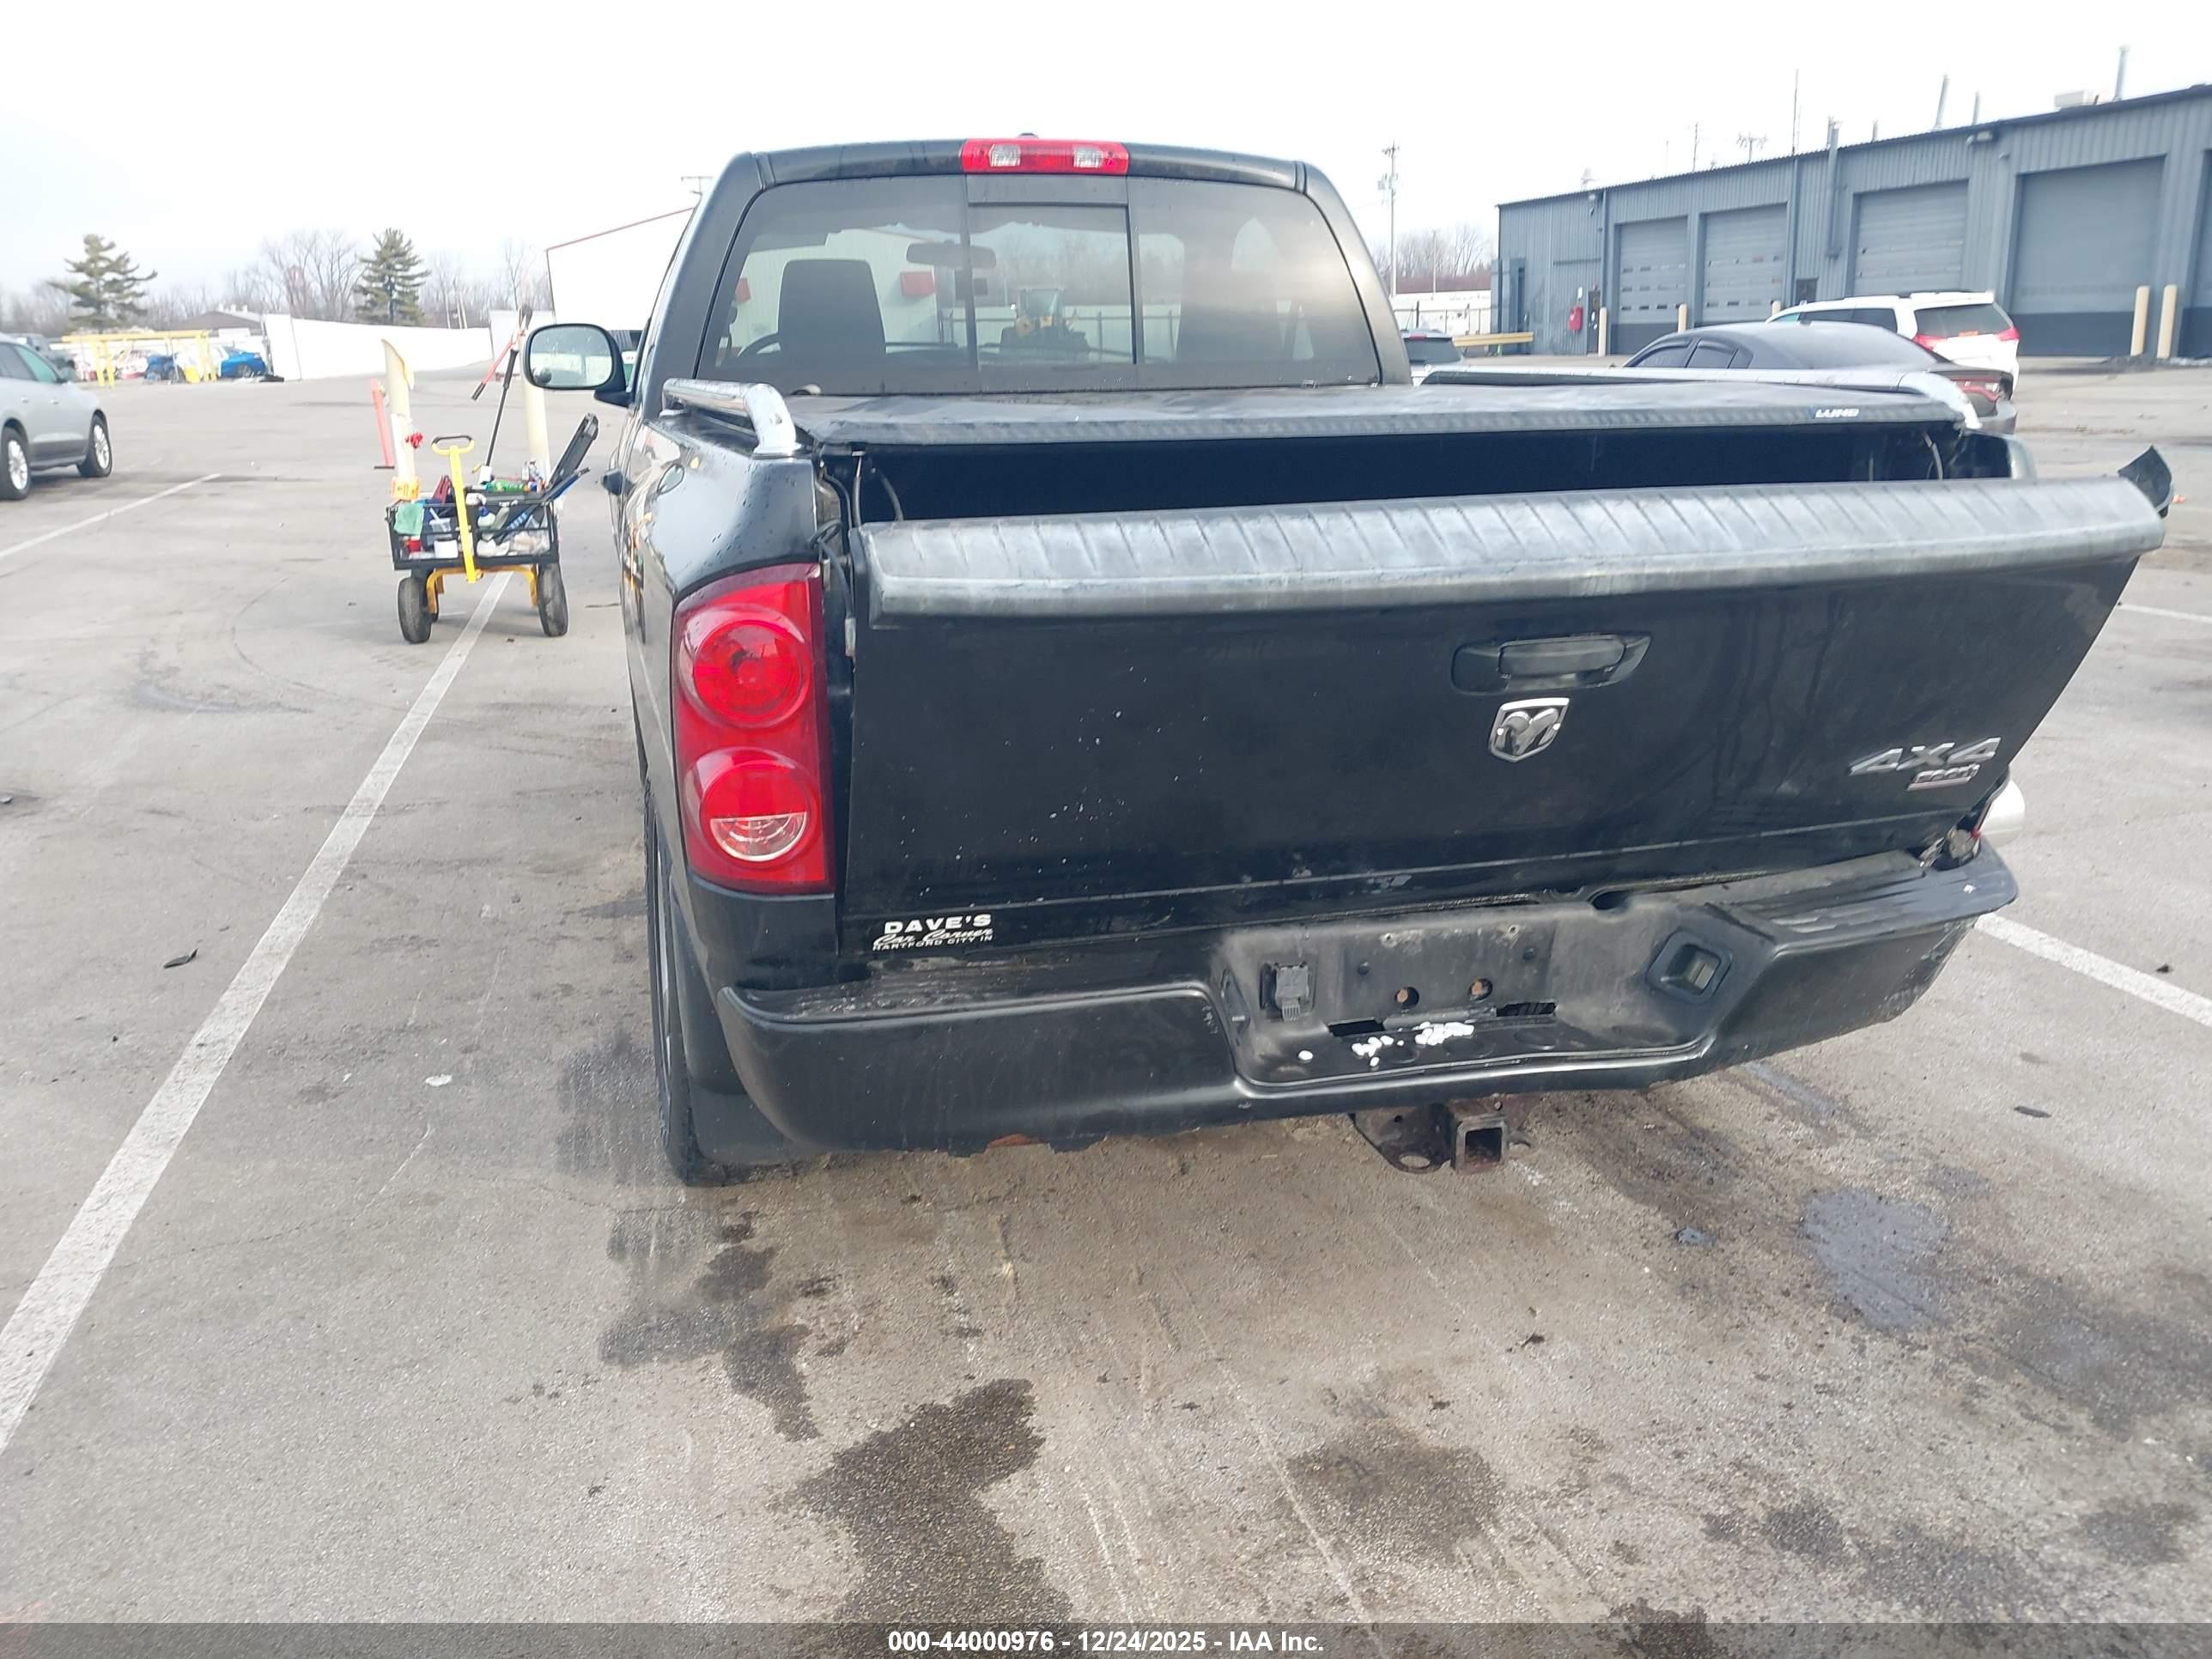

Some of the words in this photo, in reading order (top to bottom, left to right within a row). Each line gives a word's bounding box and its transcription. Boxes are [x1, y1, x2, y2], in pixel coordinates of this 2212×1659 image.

[884, 913, 992, 934] DAVE'S
[872, 939, 943, 951] HARTFORD
[946, 936, 975, 945] CITY
[873, 933, 916, 946] Car
[921, 928, 994, 944] Corner
